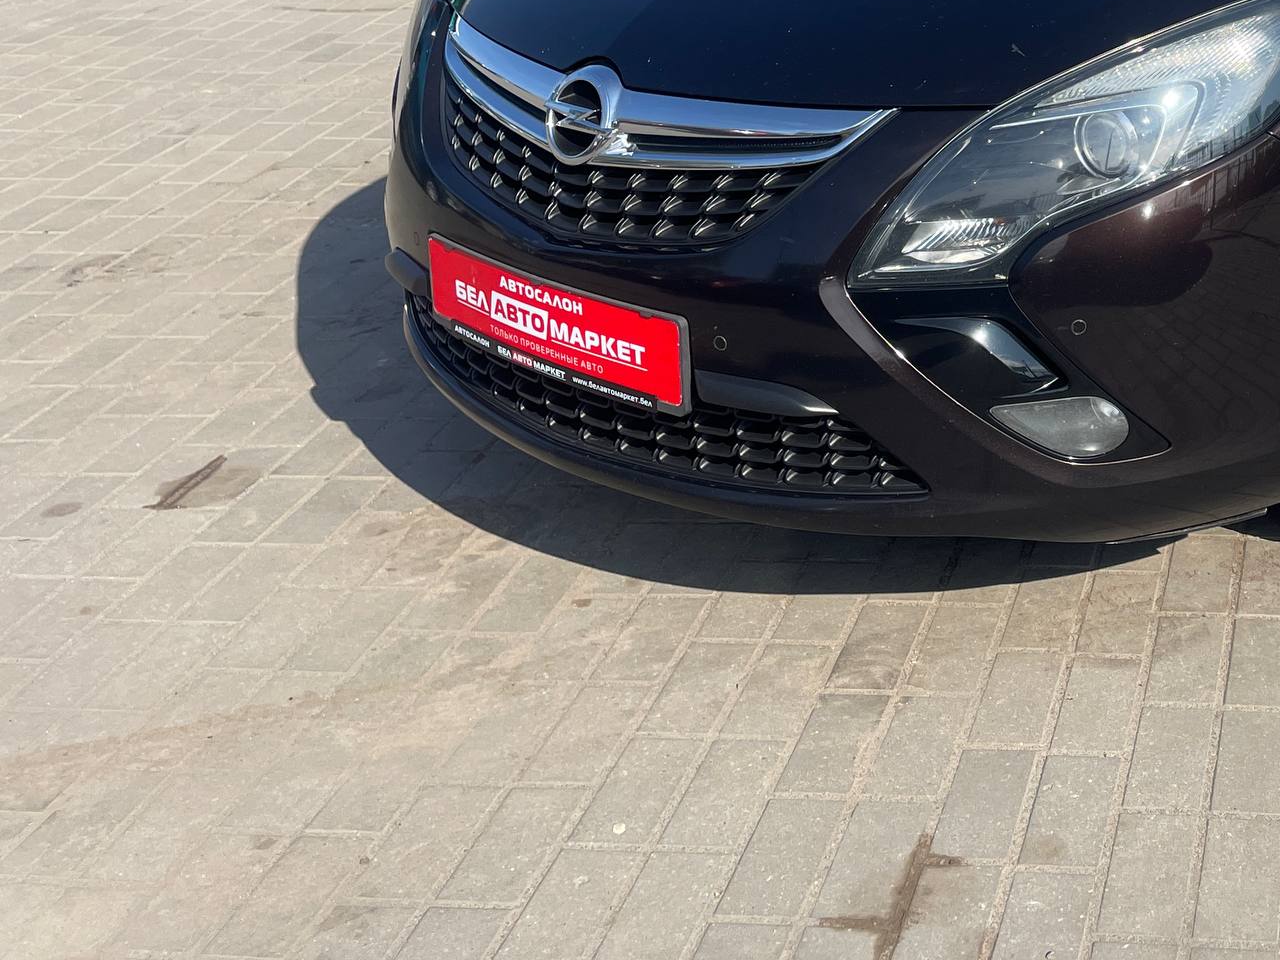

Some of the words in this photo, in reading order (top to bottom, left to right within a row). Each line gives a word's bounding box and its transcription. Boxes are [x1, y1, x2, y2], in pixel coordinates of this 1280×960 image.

[499, 275, 583, 315] АВТОСАЛОН
[455, 280, 489, 311] БЕЛ
[493, 297, 545, 334] АВТО
[550, 321, 645, 366] МАРКЕТ
[490, 324, 519, 344] ТОЛЬКО
[520, 334, 578, 366] ПРОВЕРЕННЫЕ
[580, 356, 604, 374] АВТО
[454, 324, 490, 348] АВТОСАЛОН
[497, 345, 511, 359] БЕЛ
[512, 352, 532, 368] АВТО
[533, 361, 566, 379] МАРКЕТ
